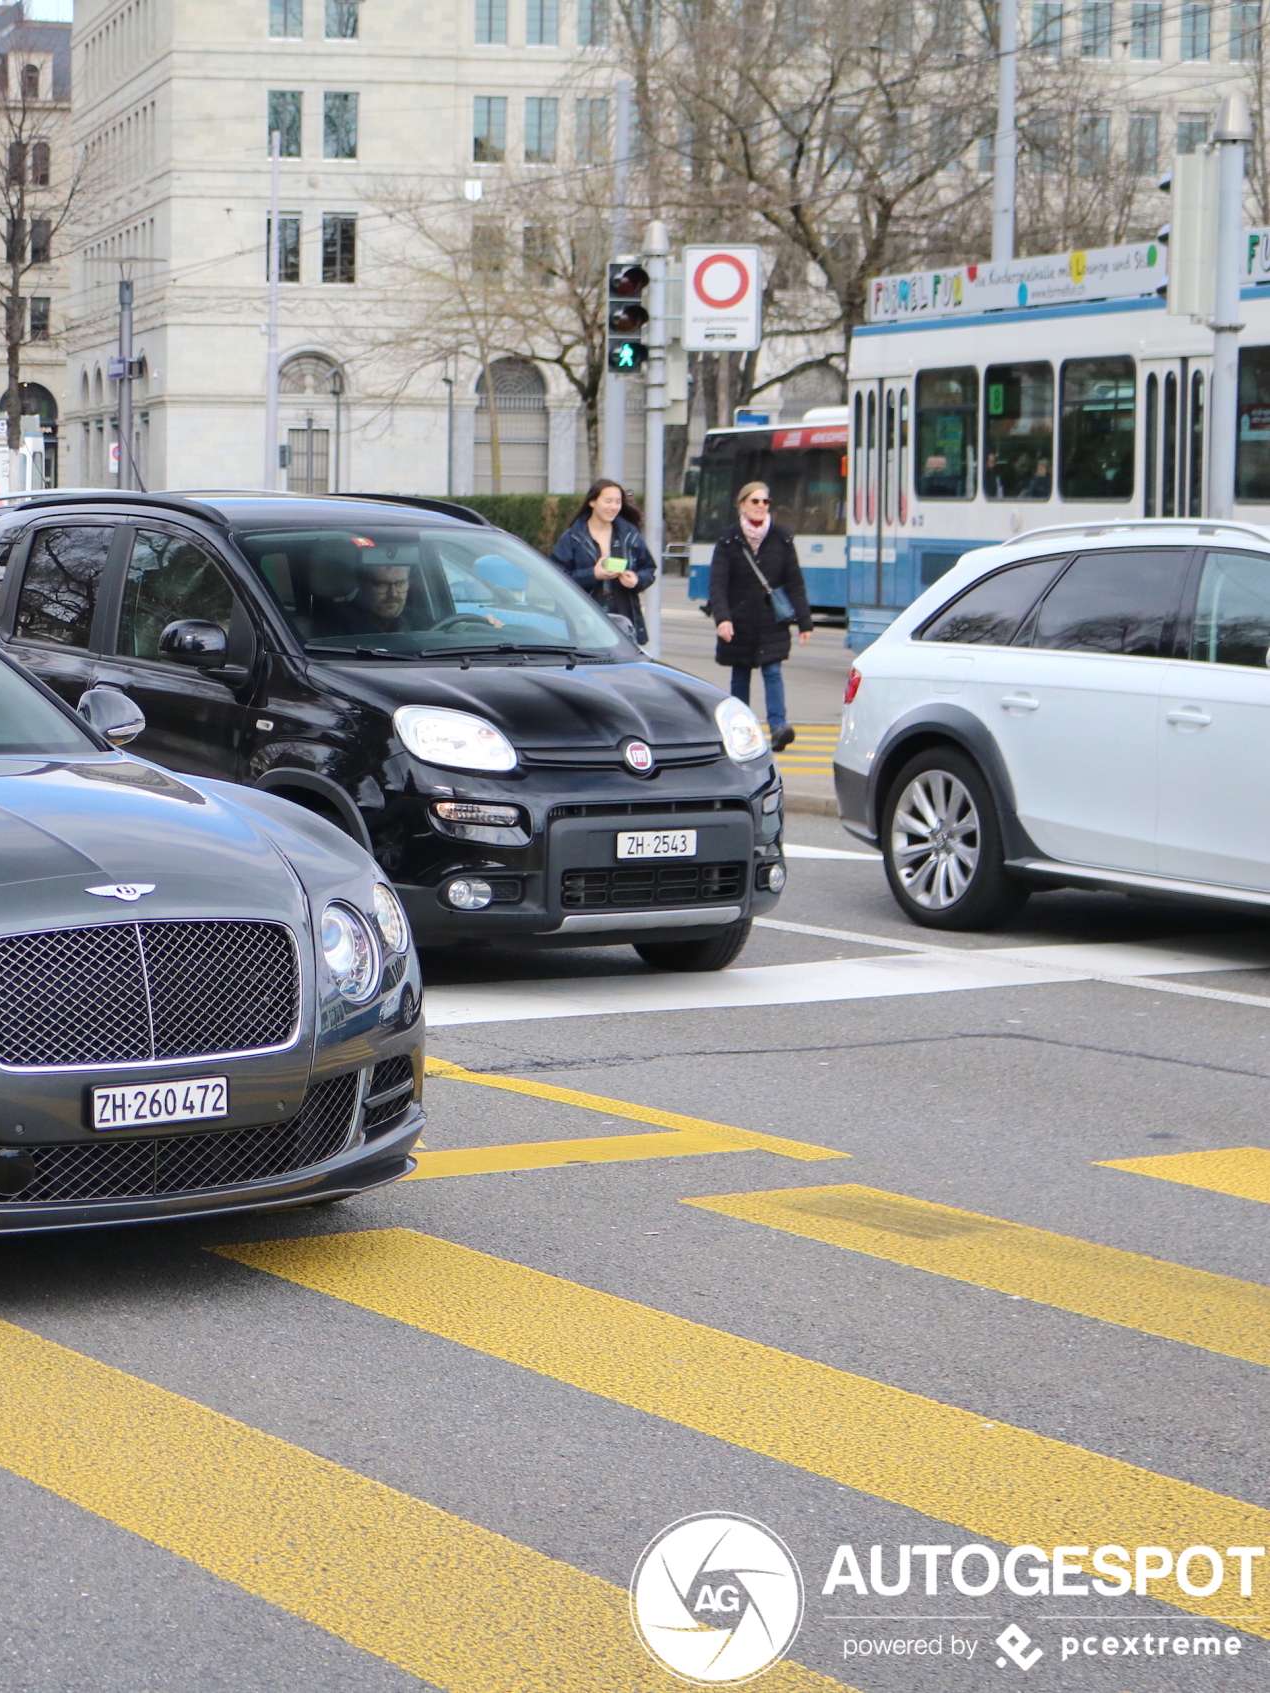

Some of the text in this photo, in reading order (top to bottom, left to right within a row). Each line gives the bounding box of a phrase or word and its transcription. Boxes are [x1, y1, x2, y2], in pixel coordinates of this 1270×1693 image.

[874, 276, 928, 314] FORMEL
[932, 271, 963, 308] FUN
[989, 264, 1055, 285] Kinderspielhalle
[1075, 258, 1109, 280] Lounge
[1113, 252, 1130, 271] und
[692, 317, 749, 325] ausgenommen
